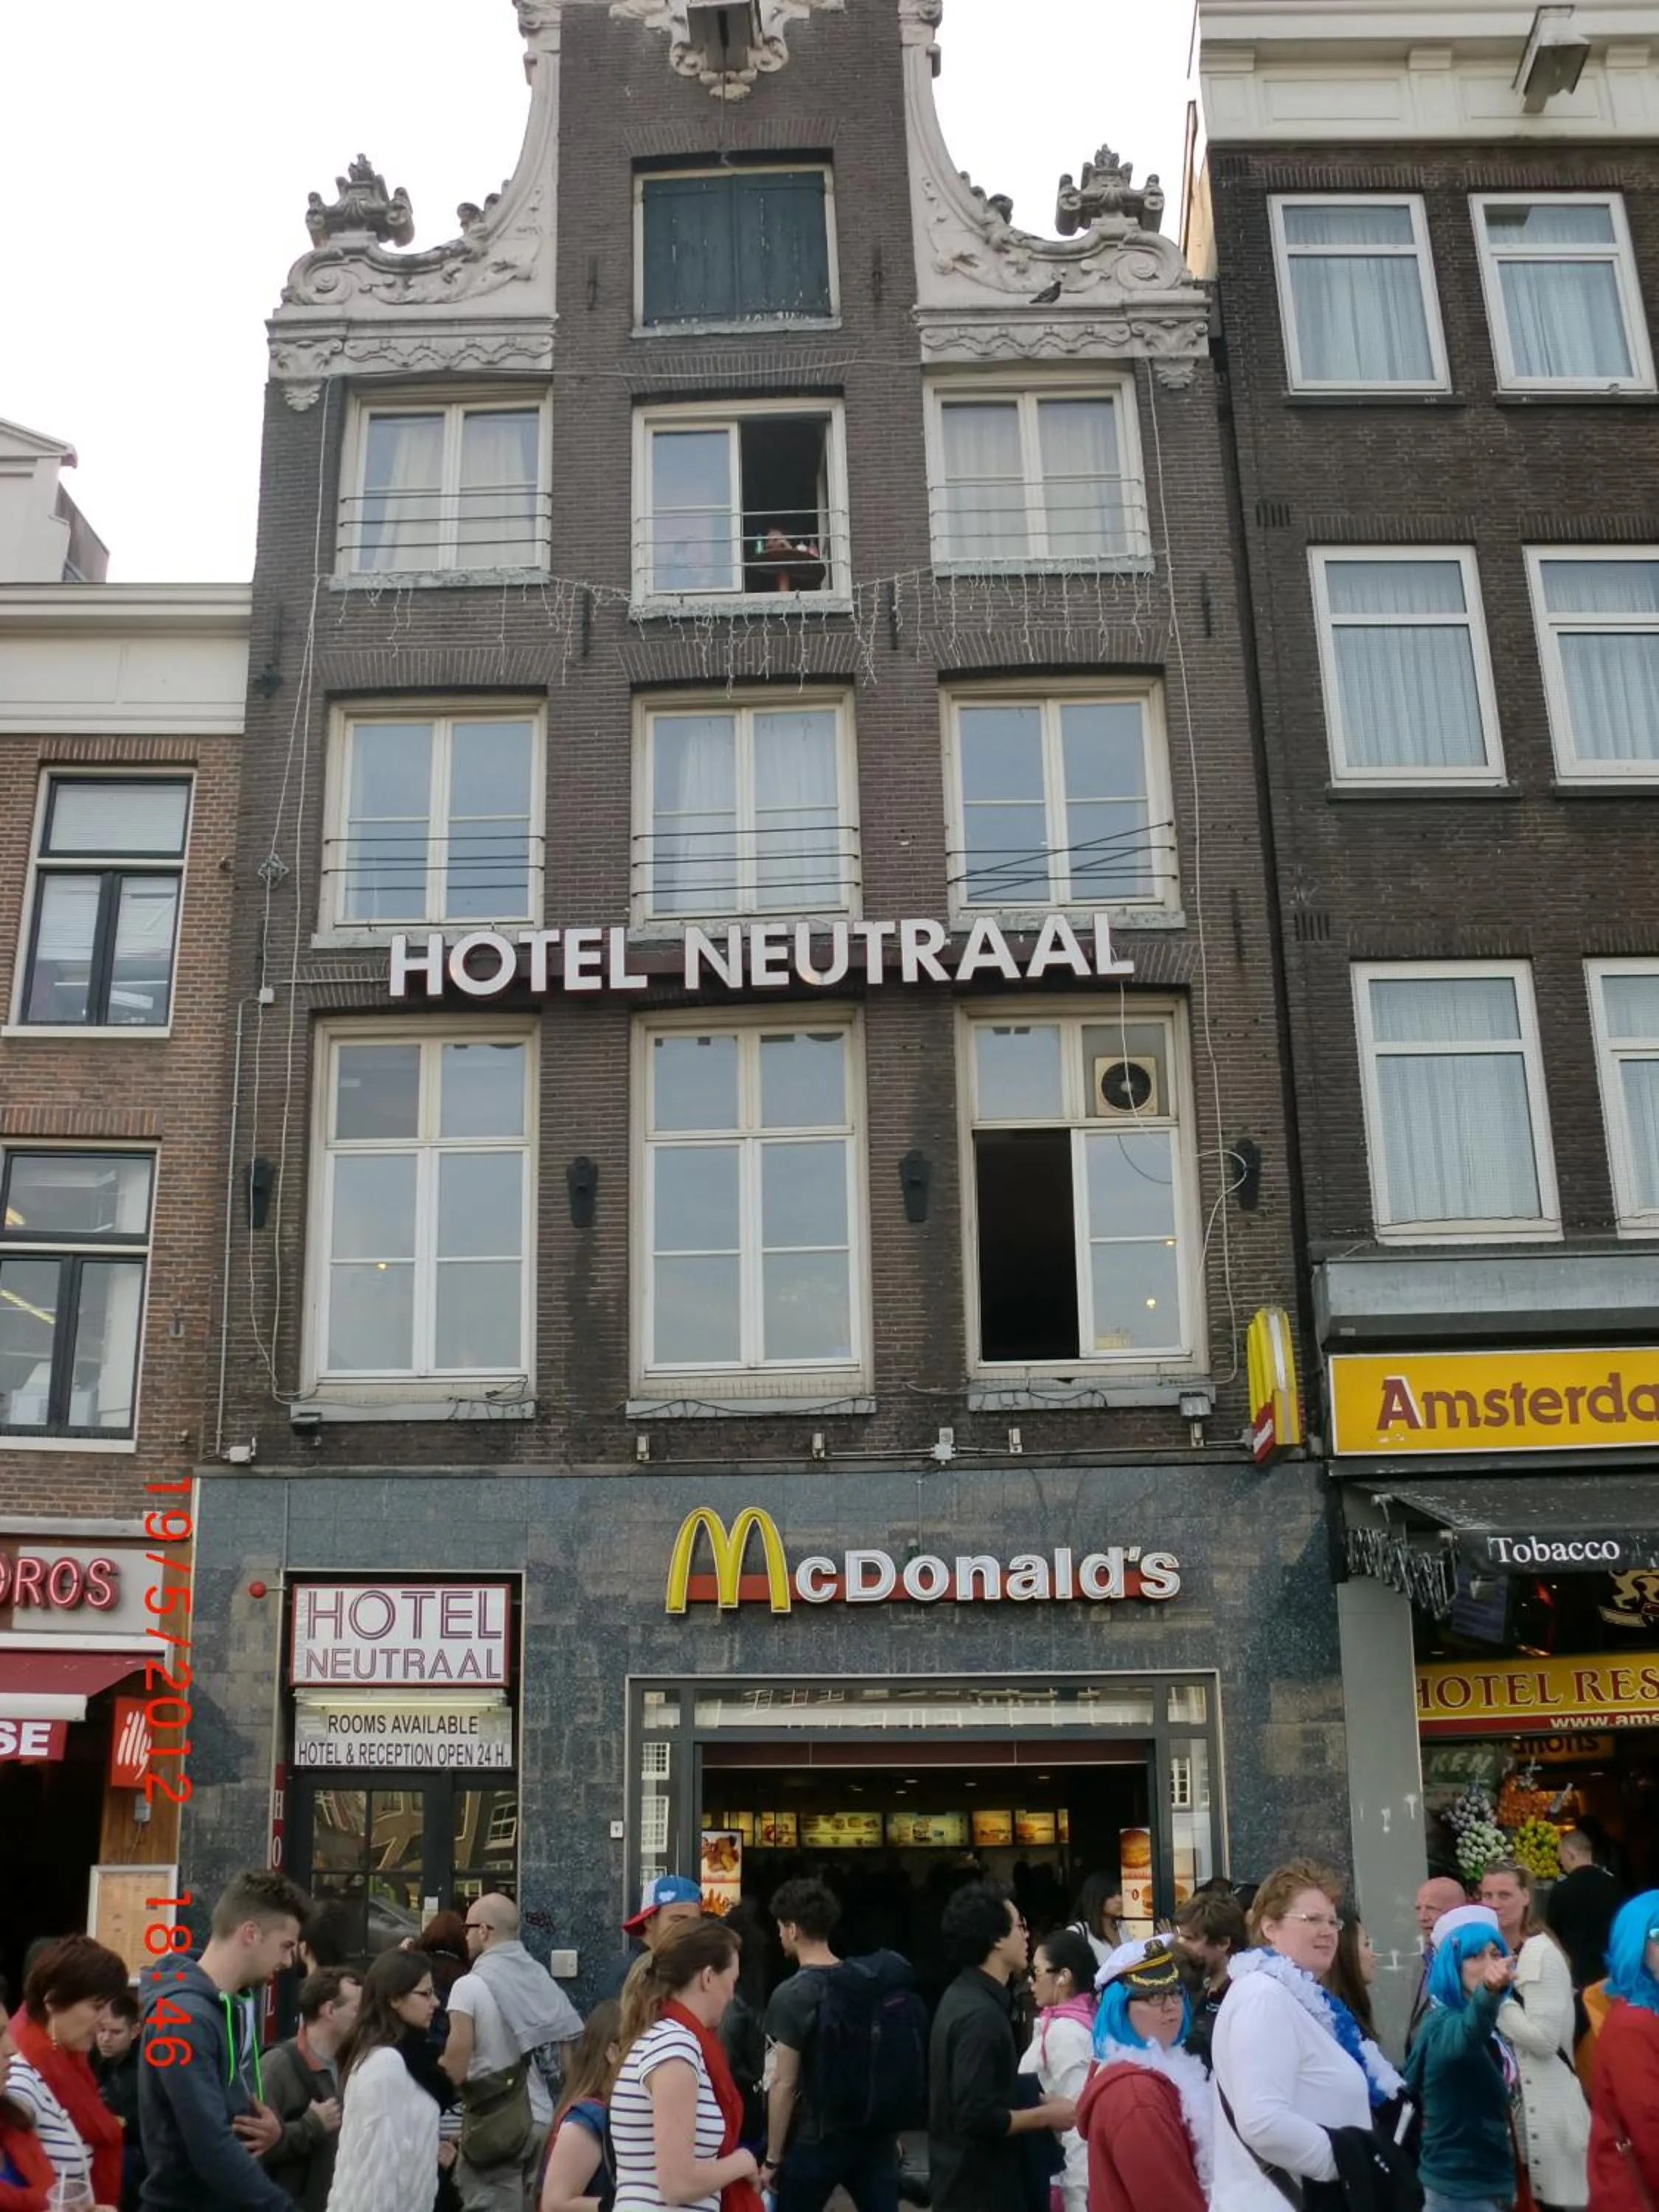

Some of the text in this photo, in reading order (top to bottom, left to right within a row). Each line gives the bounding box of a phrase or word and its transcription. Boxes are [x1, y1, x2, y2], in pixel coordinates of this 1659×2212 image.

[389, 912, 1135, 998] HOTEL NEUTRAAL
[1377, 1372, 1659, 1430] Amsterda
[666, 1506, 1181, 1615] McDonald's
[1489, 1536, 1621, 1563] Tobacco
[307, 1590, 502, 1640] HOTEL
[306, 1648, 502, 1680] NEUTRAAL
[116, 1710, 153, 1781] illy
[328, 1714, 479, 1734] ROOMS AVAILABLE
[298, 1742, 341, 1765] HOTEL
[346, 1743, 355, 1764] &
[358, 1742, 434, 1766] RECEPTION
[437, 1742, 473, 1766] OPEN
[477, 1743, 492, 1766] 24
